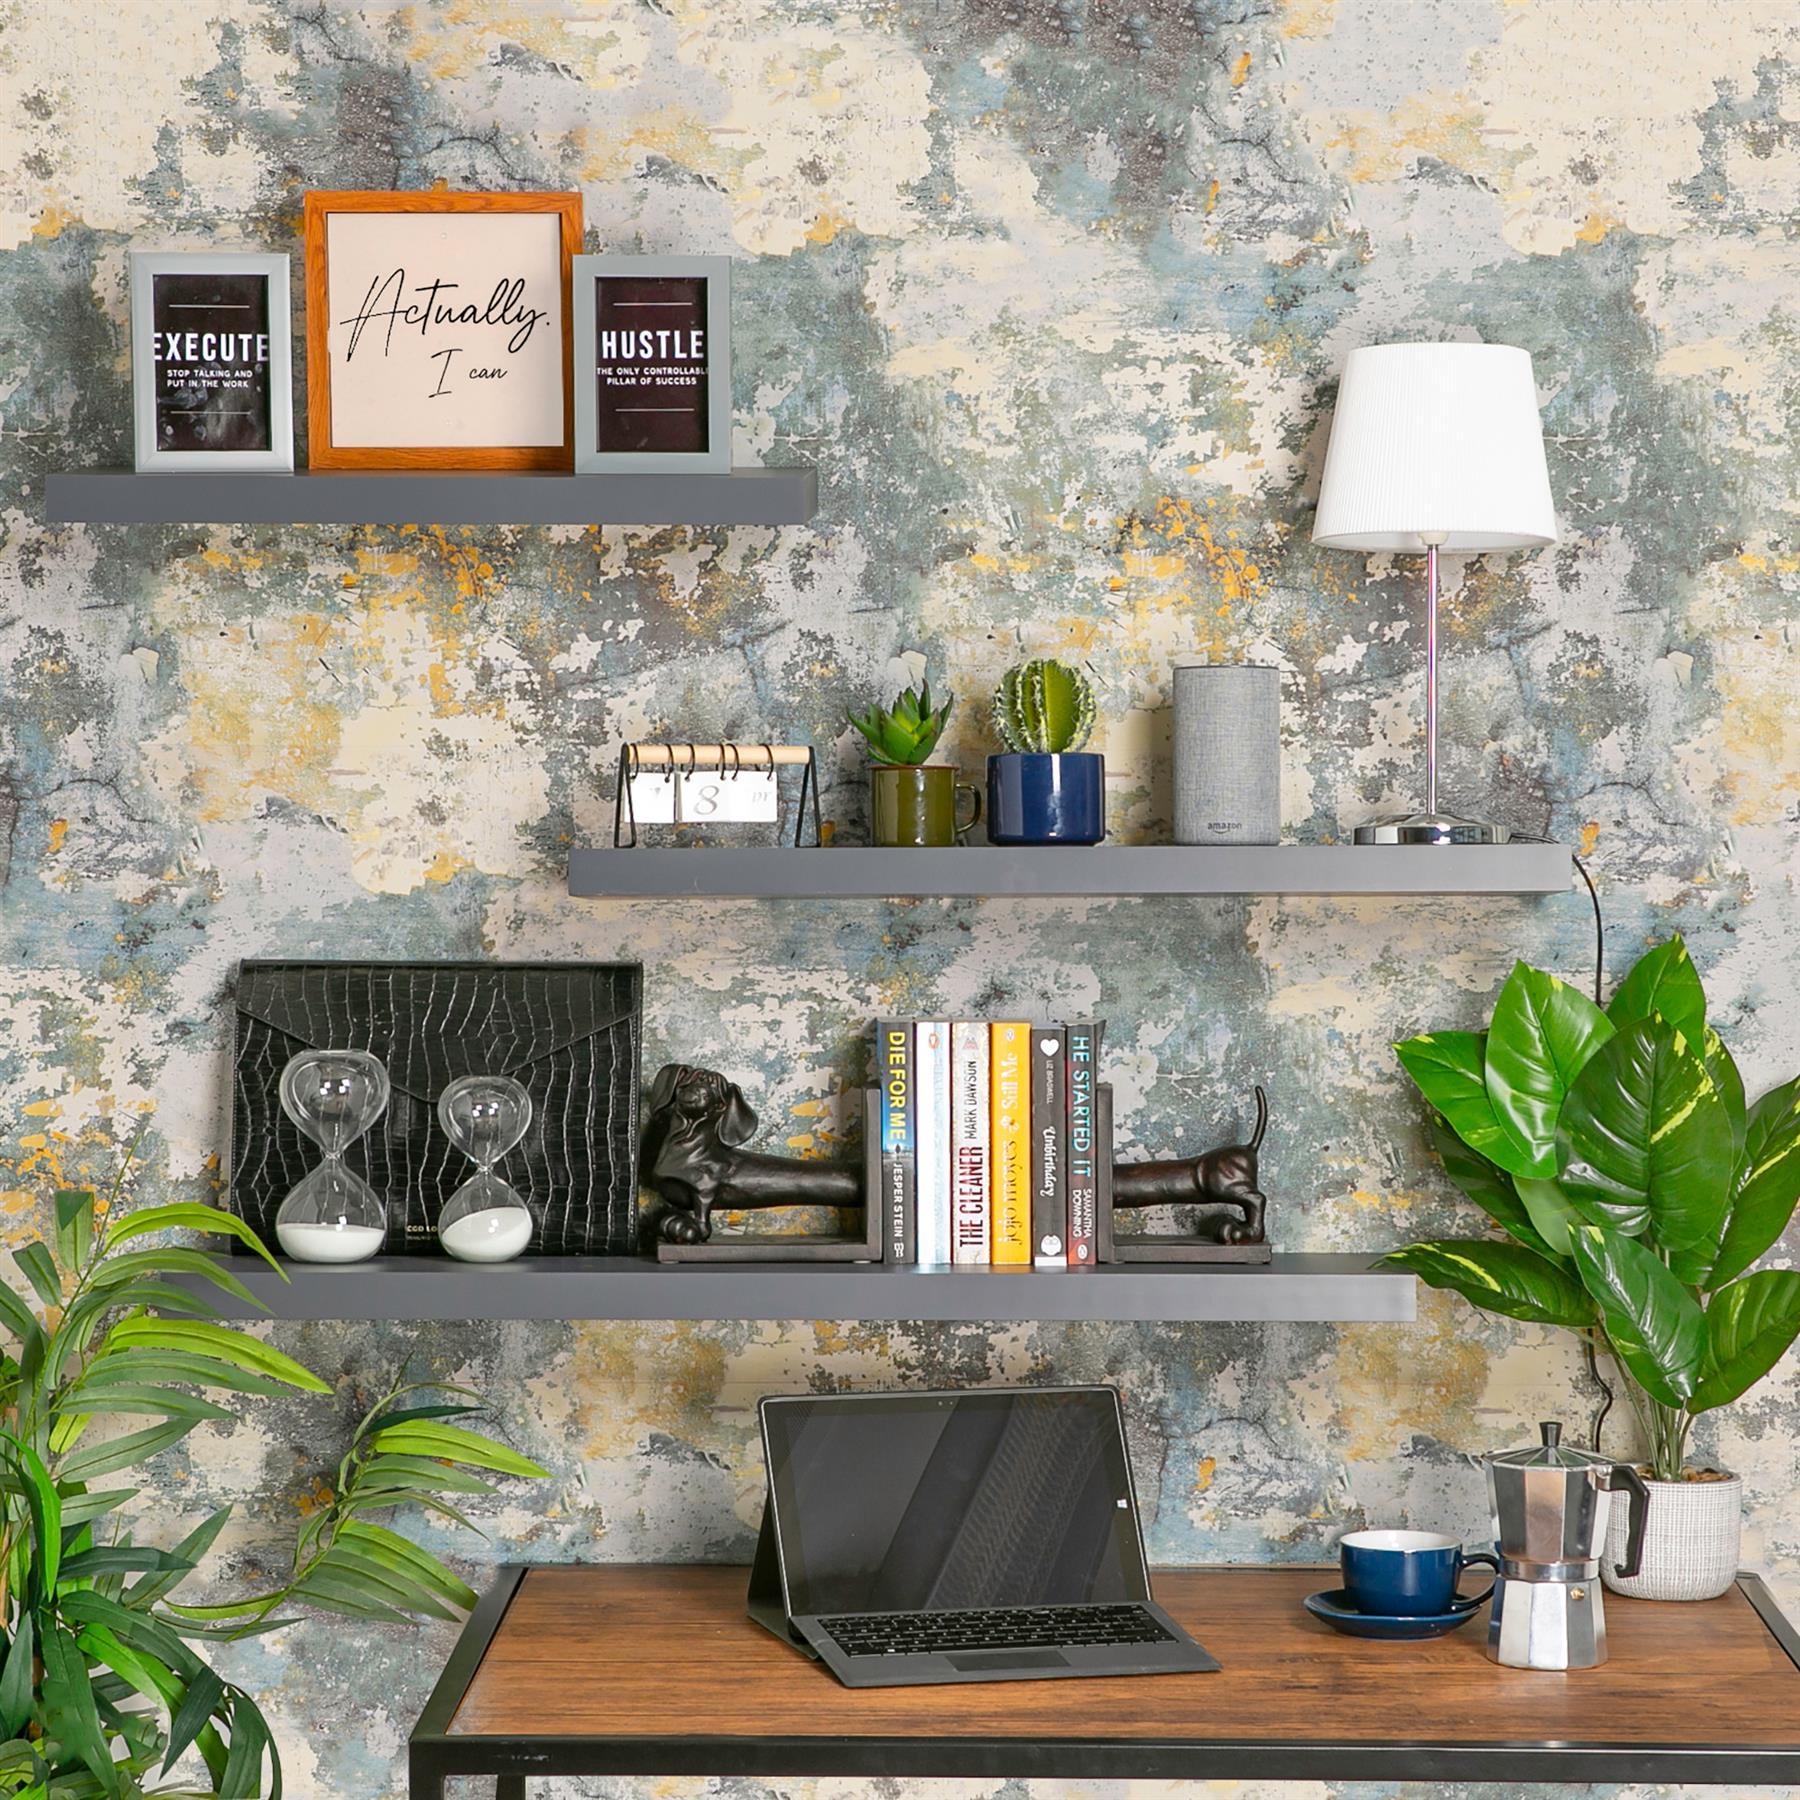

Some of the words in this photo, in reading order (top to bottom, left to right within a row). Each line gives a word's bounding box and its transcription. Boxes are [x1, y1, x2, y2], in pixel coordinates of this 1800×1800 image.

[340, 268, 550, 362] Actually.
[154, 333, 269, 361] EXECUTE
[602, 330, 704, 359] HUSTLE
[167, 369, 190, 378] STOP
[194, 369, 231, 378] TALKING
[234, 369, 253, 378] AND
[167, 380, 184, 388] PUT
[188, 380, 198, 388] IN
[202, 380, 219, 388] THE
[222, 379, 249, 388] WORK
[428, 348, 463, 398] I
[469, 368, 508, 379] can
[606, 377, 637, 385] PILLAR
[640, 377, 652, 385] OF
[655, 377, 697, 385] SUCCESS
[616, 367, 640, 376] ONLY
[693, 785, 720, 815] 8
[1207, 822, 1242, 834] amazon
[889, 1032, 906, 1065] DIE
[1072, 1036, 1090, 1063] HE
[1001, 1052, 1018, 1079] Me
[889, 1069, 906, 1108] FOR
[965, 1060, 977, 1107] DAWSON
[1001, 1080, 1019, 1111] Still
[889, 1112, 906, 1140] ME
[965, 1107, 977, 1140] MARK
[1072, 1070, 1091, 1152] STARTED
[1040, 1126, 1057, 1197] Unbirthday
[1073, 1160, 1091, 1178] IT
[893, 1163, 905, 1204] JESPER
[959, 1146, 983, 1214] CLEANER
[893, 1206, 904, 1238] STEIN
[1072, 1189, 1082, 1238] DOWNING
[1083, 1189, 1092, 1239] SAMANTHA
[959, 1218, 983, 1248] THE
